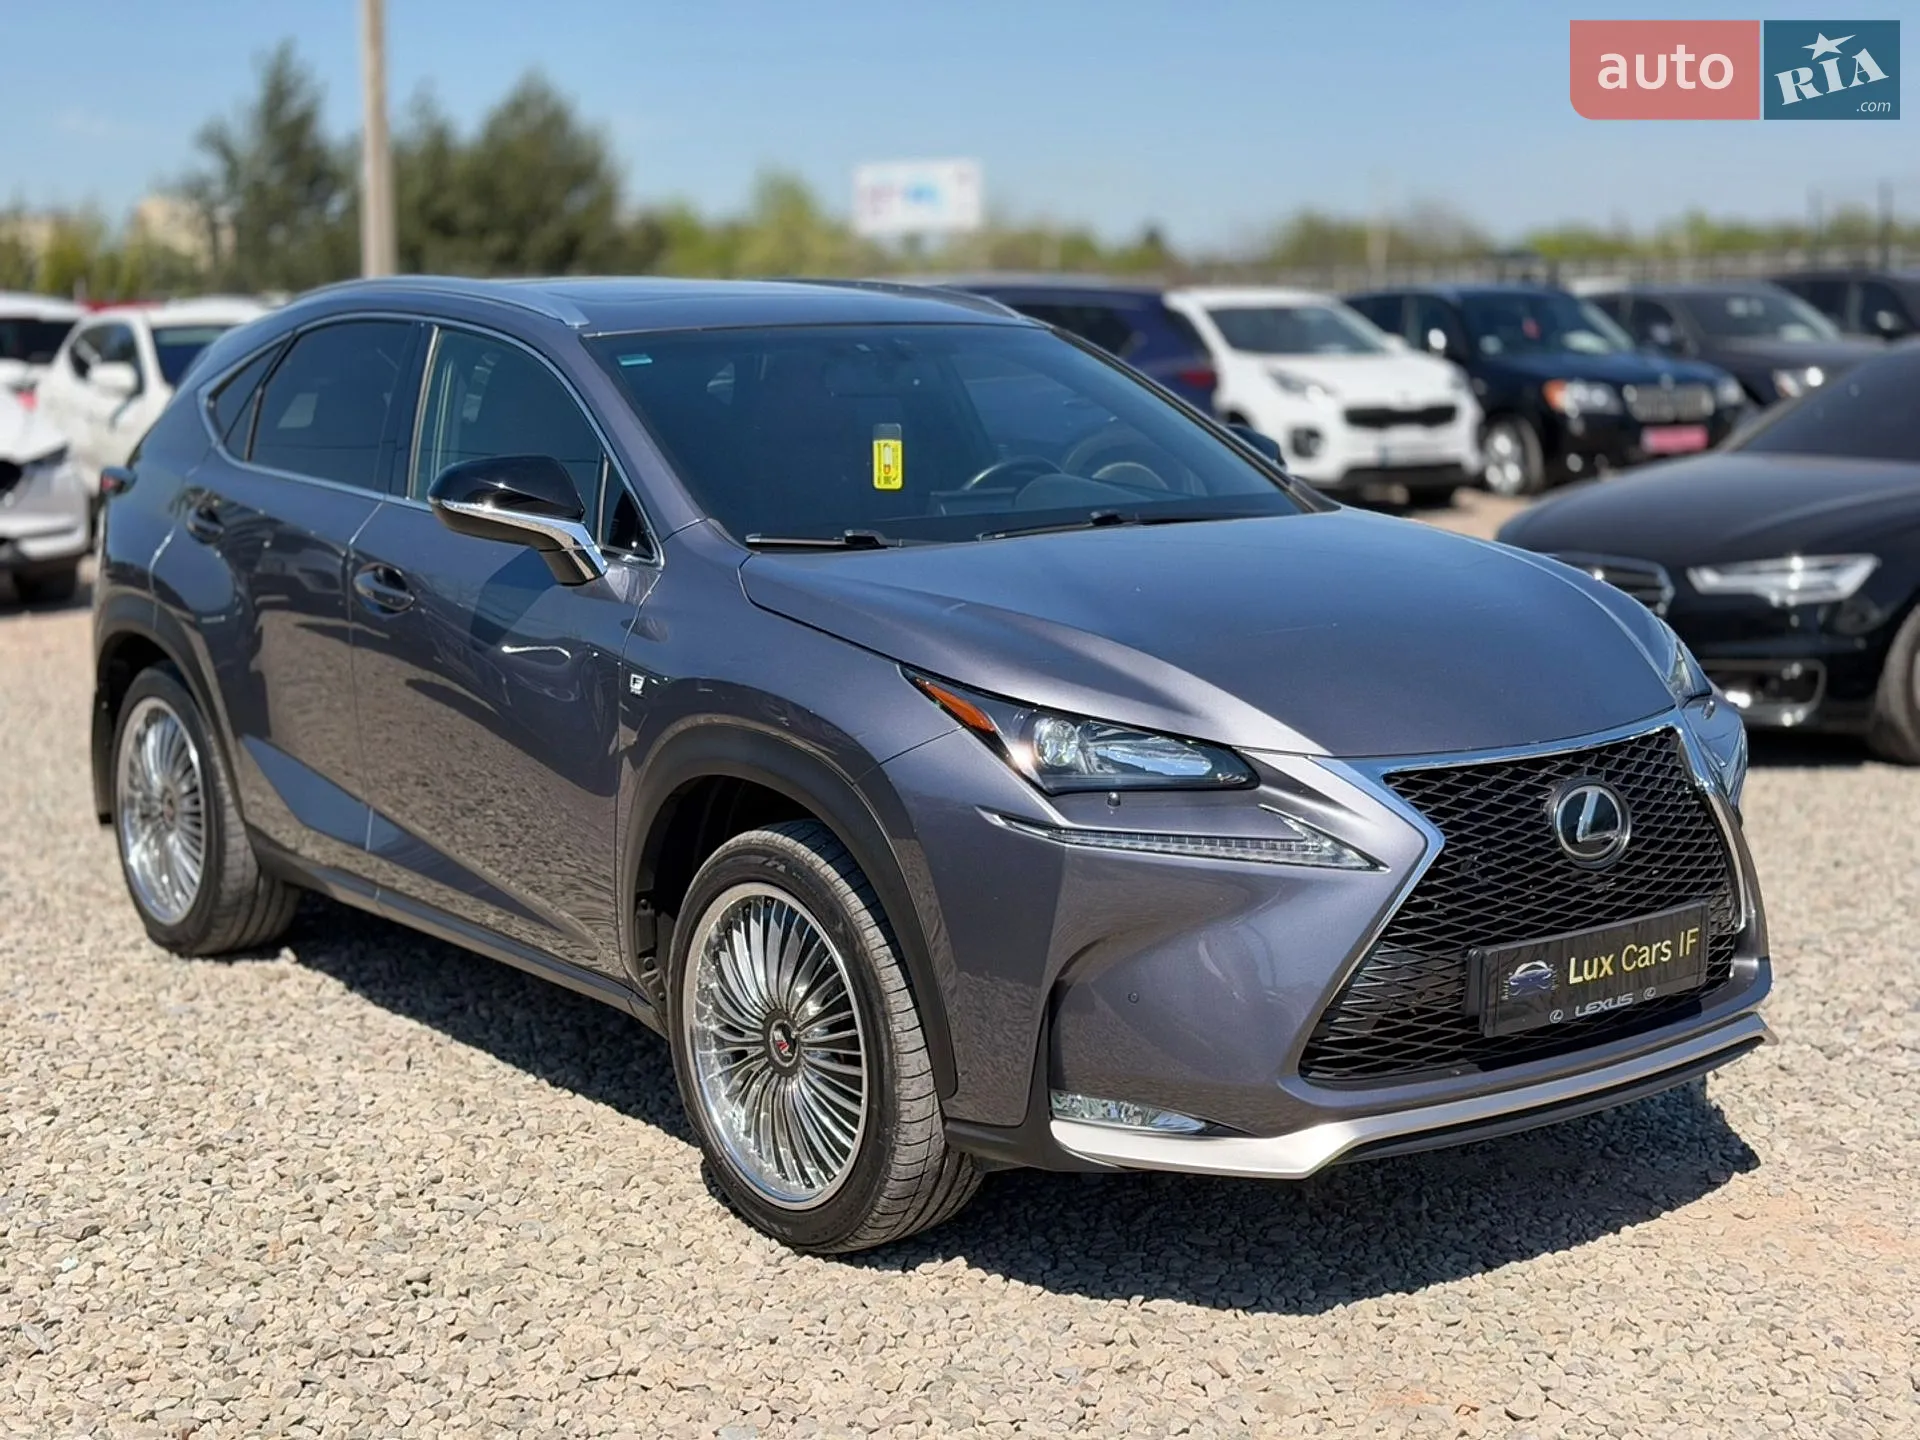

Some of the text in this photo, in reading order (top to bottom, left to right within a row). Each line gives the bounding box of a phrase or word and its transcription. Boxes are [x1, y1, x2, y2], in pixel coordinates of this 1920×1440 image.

[1568, 953, 1615, 985] Lux
[1621, 938, 1672, 972] Cars
[1678, 927, 1699, 957] IF
[1574, 992, 1634, 1018] LEXUS
